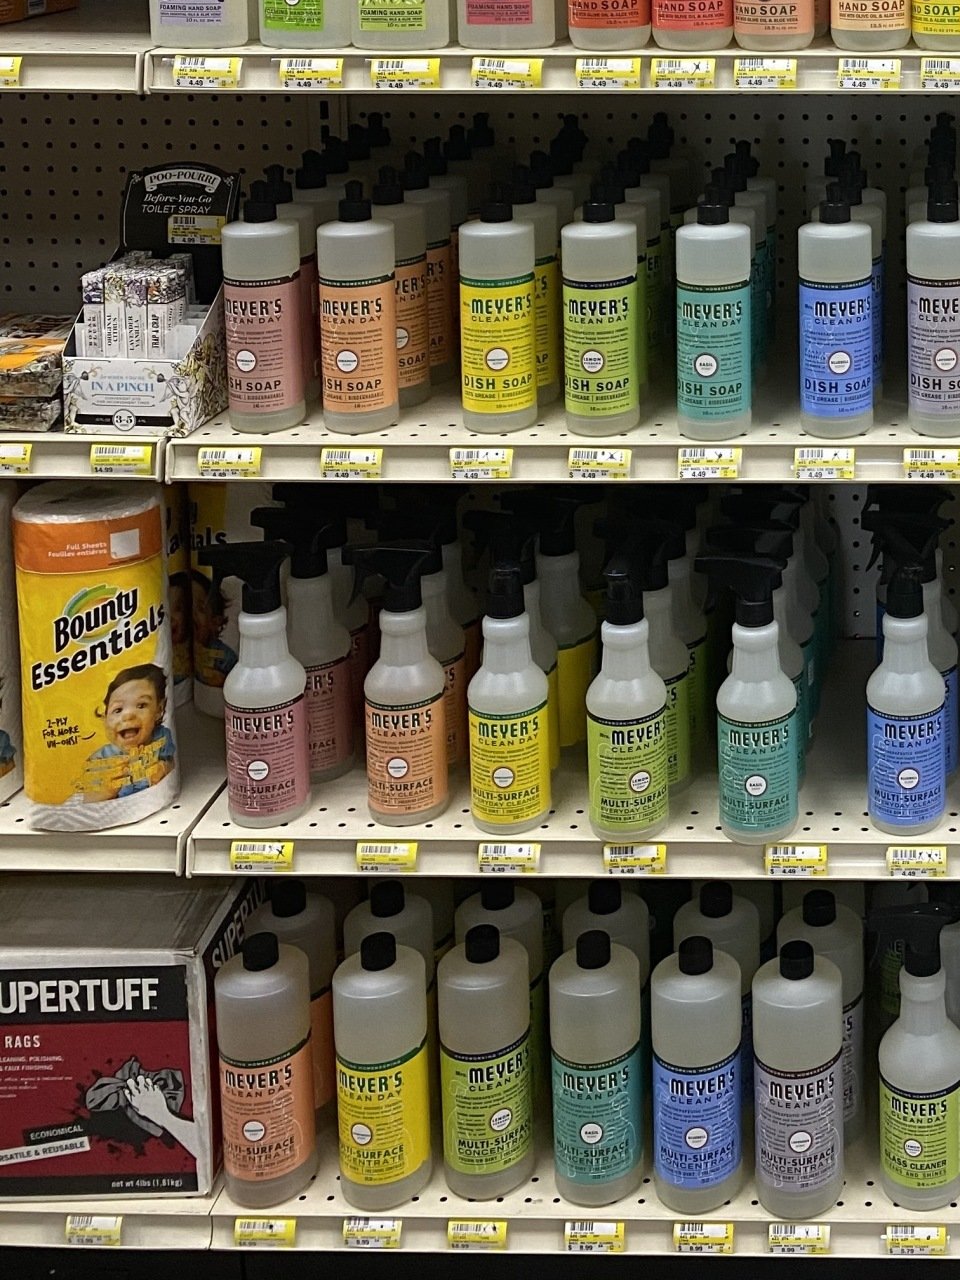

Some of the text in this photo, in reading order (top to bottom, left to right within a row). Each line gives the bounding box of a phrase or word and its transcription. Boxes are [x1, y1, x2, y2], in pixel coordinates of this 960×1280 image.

[150, 171, 217, 185] POO-POURRI
[144, 194, 212, 203] Before-You-Go
[142, 205, 210, 214] TOILET SPRAY
[471, 295, 532, 313] MEYER'S
[683, 301, 742, 318] MEYER'S
[815, 299, 871, 315] MEYER'S
[92, 382, 154, 392] IN A PINCH
[805, 379, 871, 393] DISH SOAP
[115, 415, 133, 425] 3-5
[82, 541, 107, 549] Sheets
[53, 588, 138, 653] Bounty
[32, 603, 165, 691] Essentials
[47, 717, 68, 728] 2-PLY
[372, 710, 431, 730] MEYER'S
[43, 725, 79, 738] FOR MORE
[729, 727, 788, 744] MEYER'S
[0, 978, 158, 1013] UPERTUFF
[5, 1036, 40, 1048] RAGS
[671, 1068, 735, 1096] MEYER'S
[891, 1098, 947, 1114] MEYER'S
[30, 1125, 83, 1140] ECONOMICAL
[42, 1142, 85, 1155] REUSABLE
